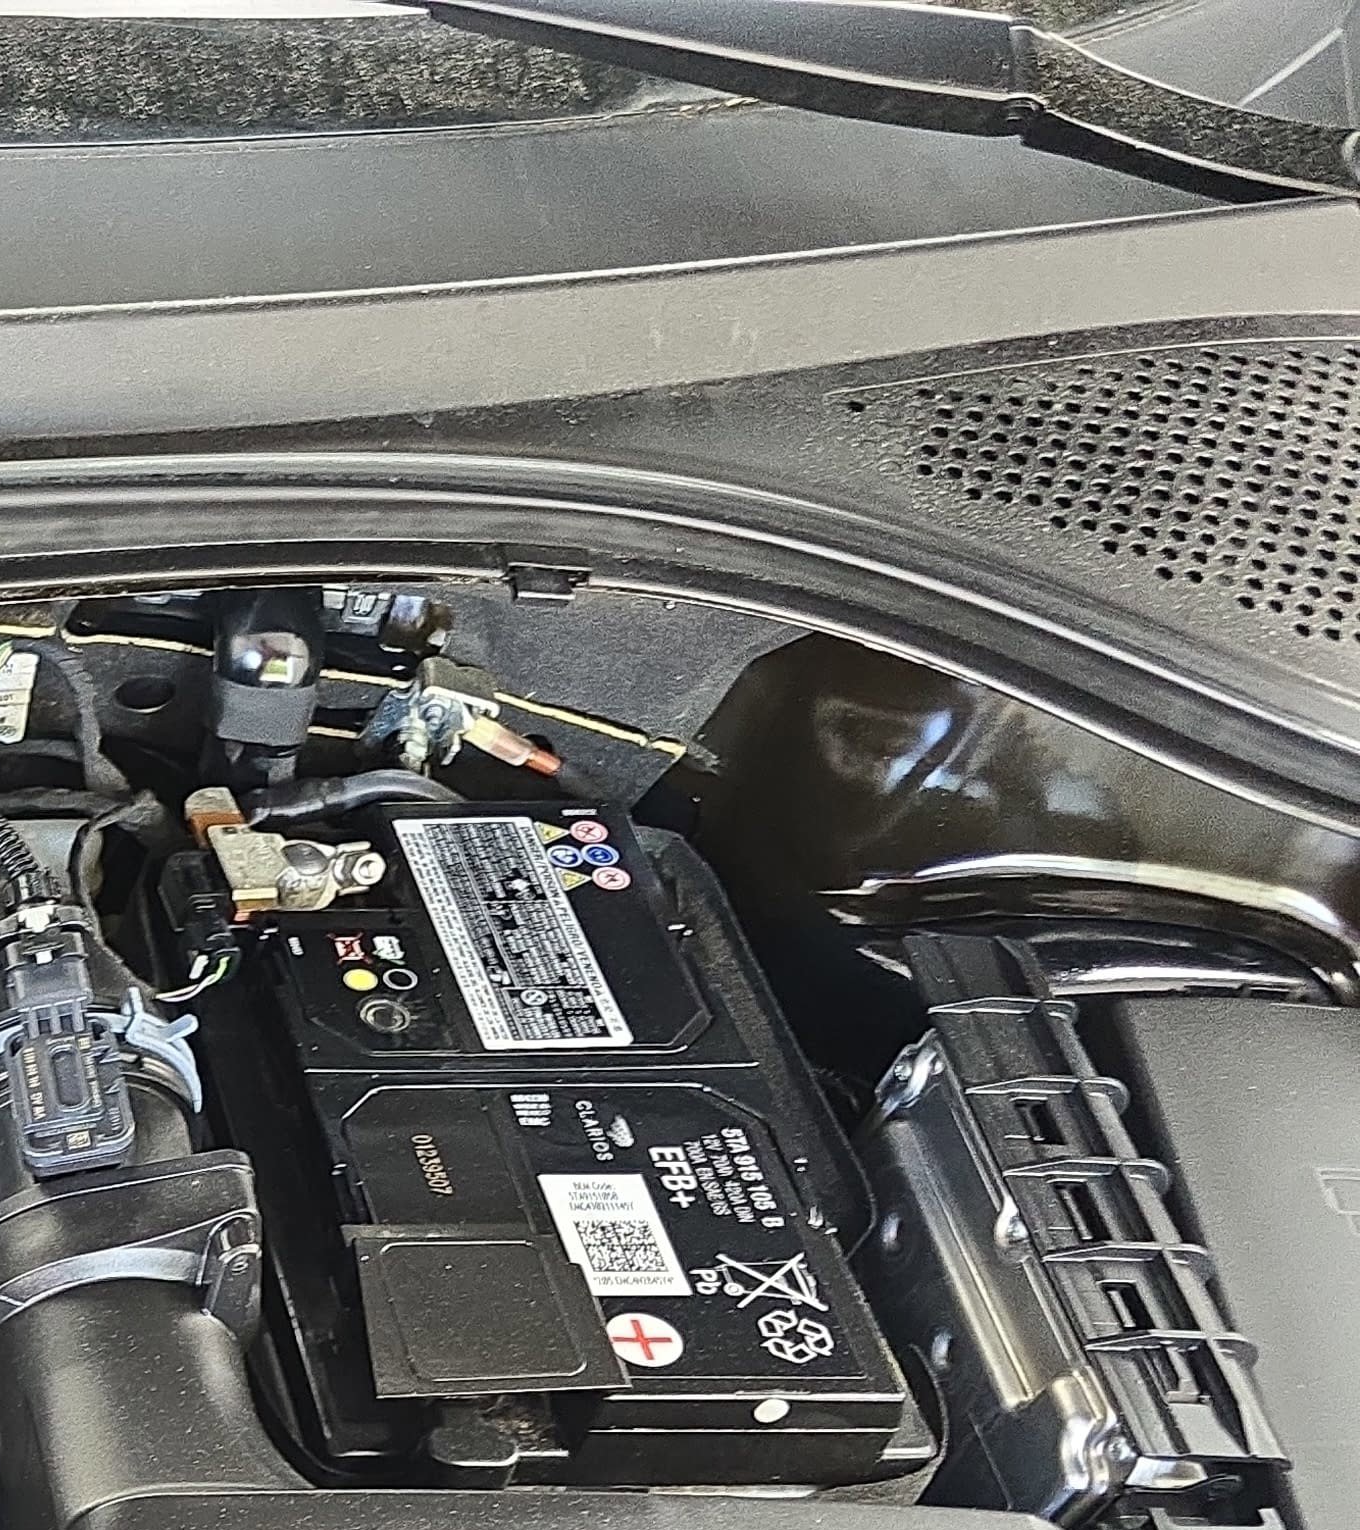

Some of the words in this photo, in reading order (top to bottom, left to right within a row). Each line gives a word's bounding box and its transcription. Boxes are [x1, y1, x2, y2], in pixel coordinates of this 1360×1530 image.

[575, 1100, 613, 1161] CLARIOS
[721, 1128, 750, 1154] 5TA
[648, 1146, 699, 1209] EFB+
[733, 1154, 764, 1181] 915
[689, 1268, 722, 1296] Pb
